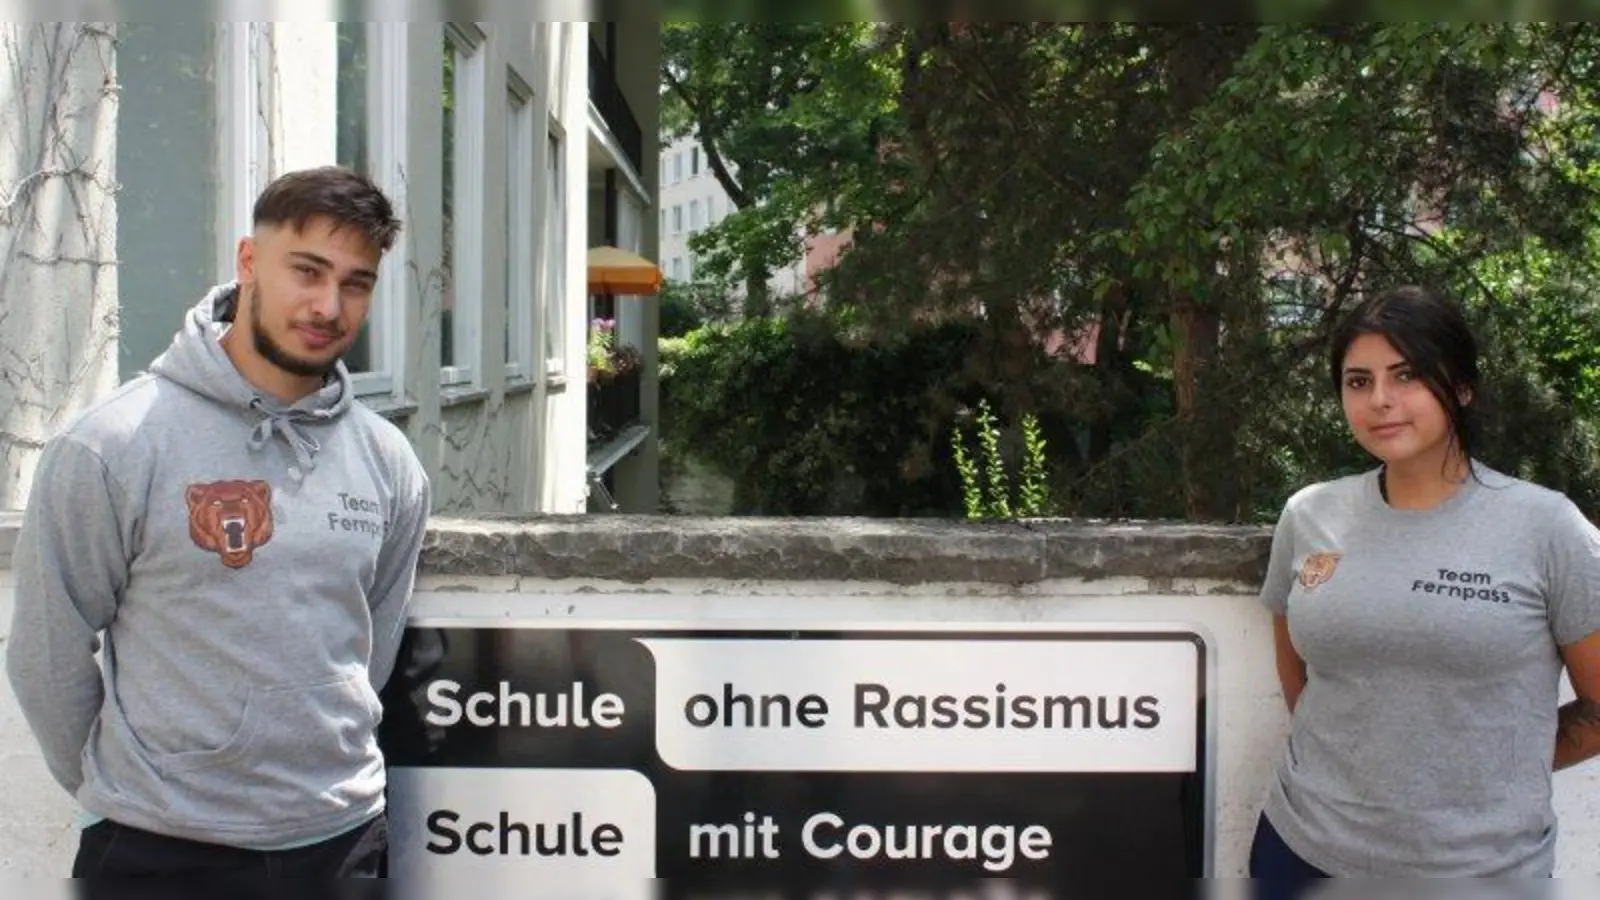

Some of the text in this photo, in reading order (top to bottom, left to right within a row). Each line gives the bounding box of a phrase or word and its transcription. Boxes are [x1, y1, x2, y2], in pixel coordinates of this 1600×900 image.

[1411, 579, 1511, 604] Fernpass
[1437, 568, 1491, 585] Team
[425, 679, 1161, 729] Schule ohne Rassismus
[425, 809, 1053, 871] Schule mit Courage
